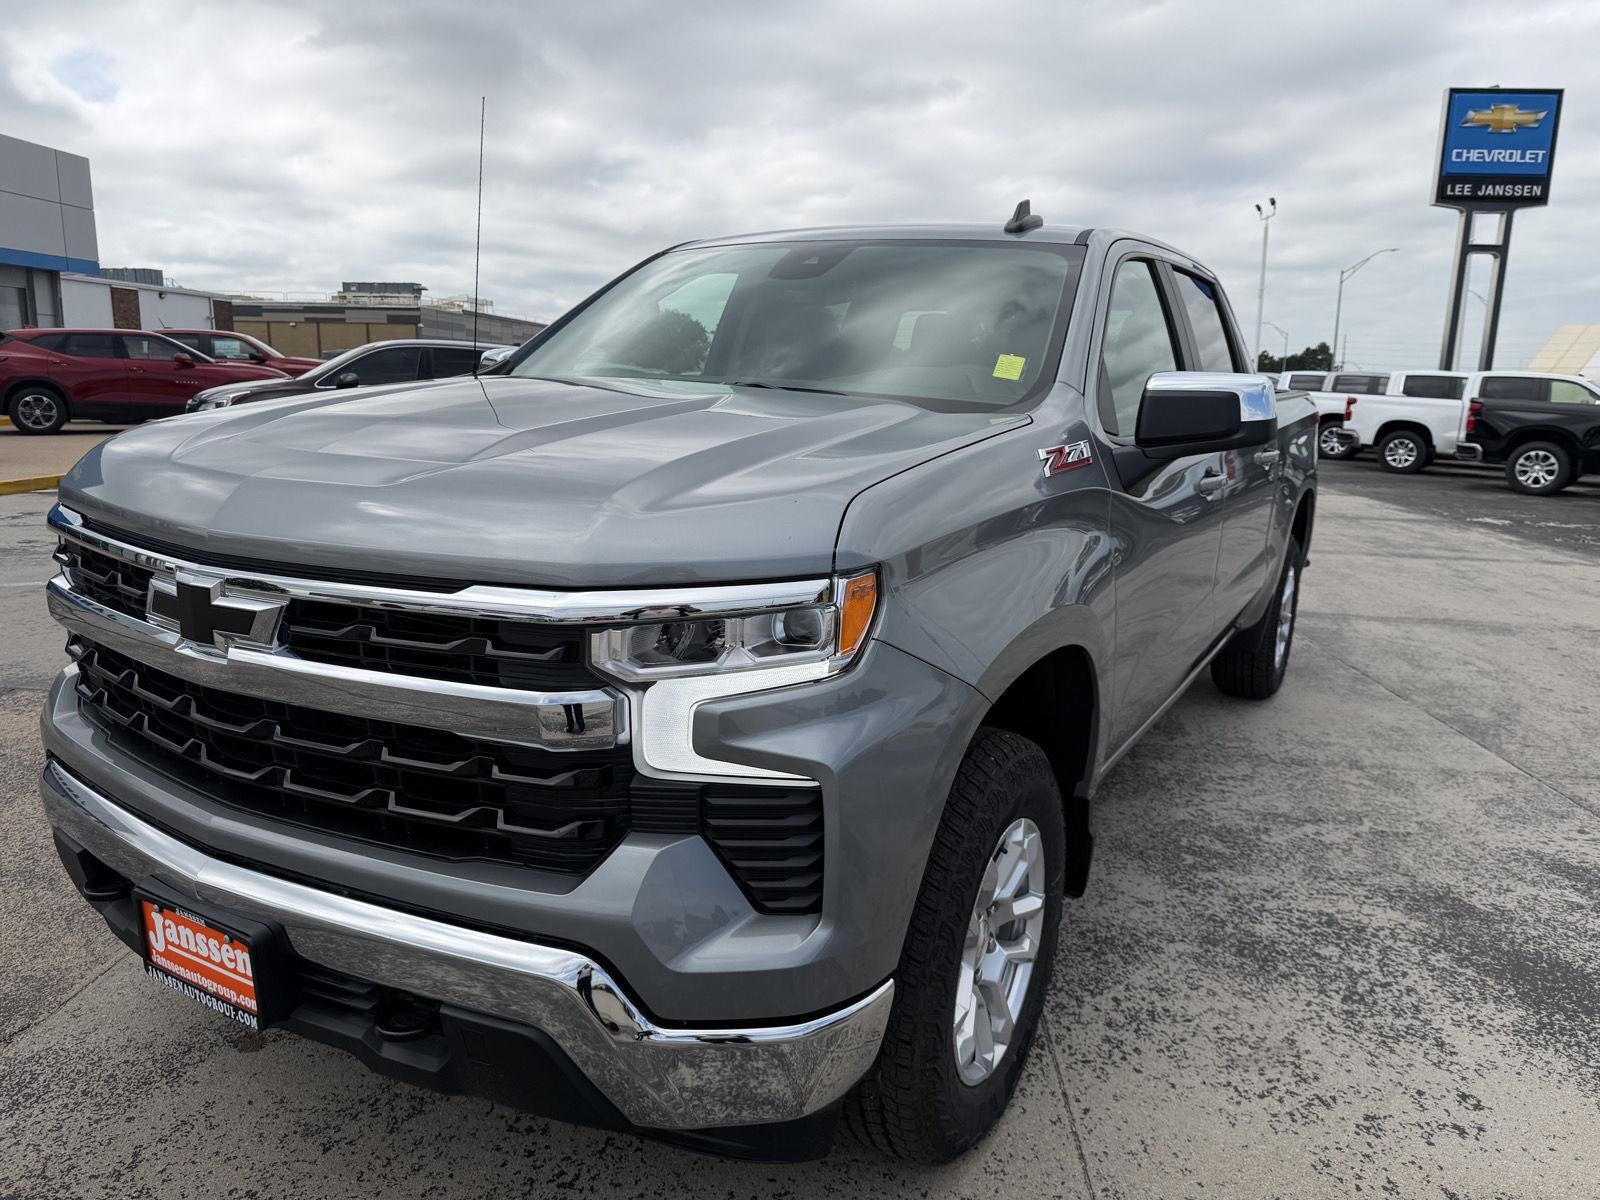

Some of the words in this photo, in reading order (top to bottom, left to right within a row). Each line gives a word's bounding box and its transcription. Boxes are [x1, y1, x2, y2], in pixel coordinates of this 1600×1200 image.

[1451, 149, 1546, 163] CHEVROLET
[1447, 184, 1472, 195] LEE
[1478, 185, 1542, 196] JANSSEN
[1037, 440, 1092, 478] Z71
[149, 911, 253, 977] Janssen
